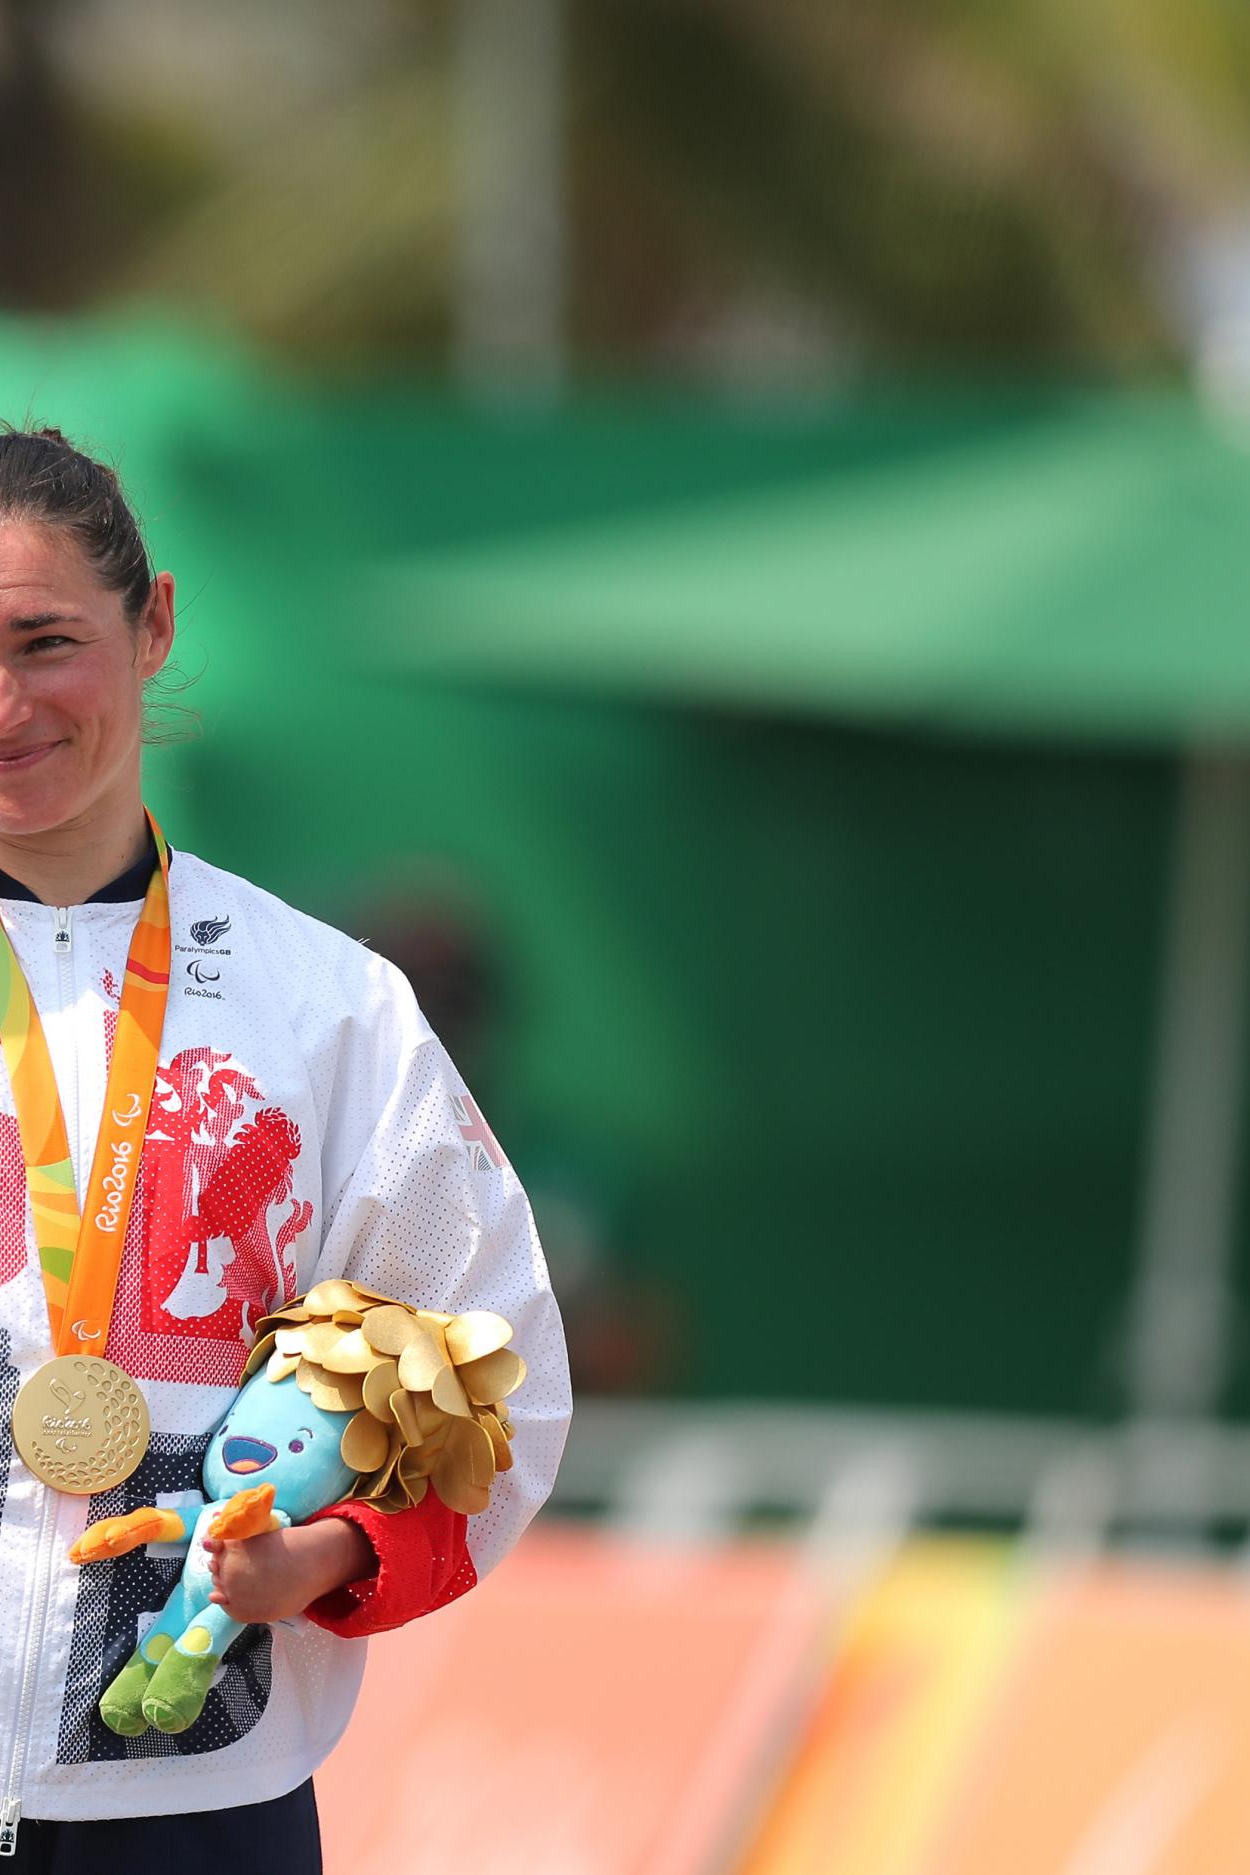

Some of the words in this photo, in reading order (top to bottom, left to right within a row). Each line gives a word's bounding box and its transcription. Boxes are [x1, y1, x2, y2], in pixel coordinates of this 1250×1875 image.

[174, 944, 232, 956] ParalympicsGB
[184, 987, 222, 1000] Rio2016
[94, 1141, 133, 1232] Rio2016
